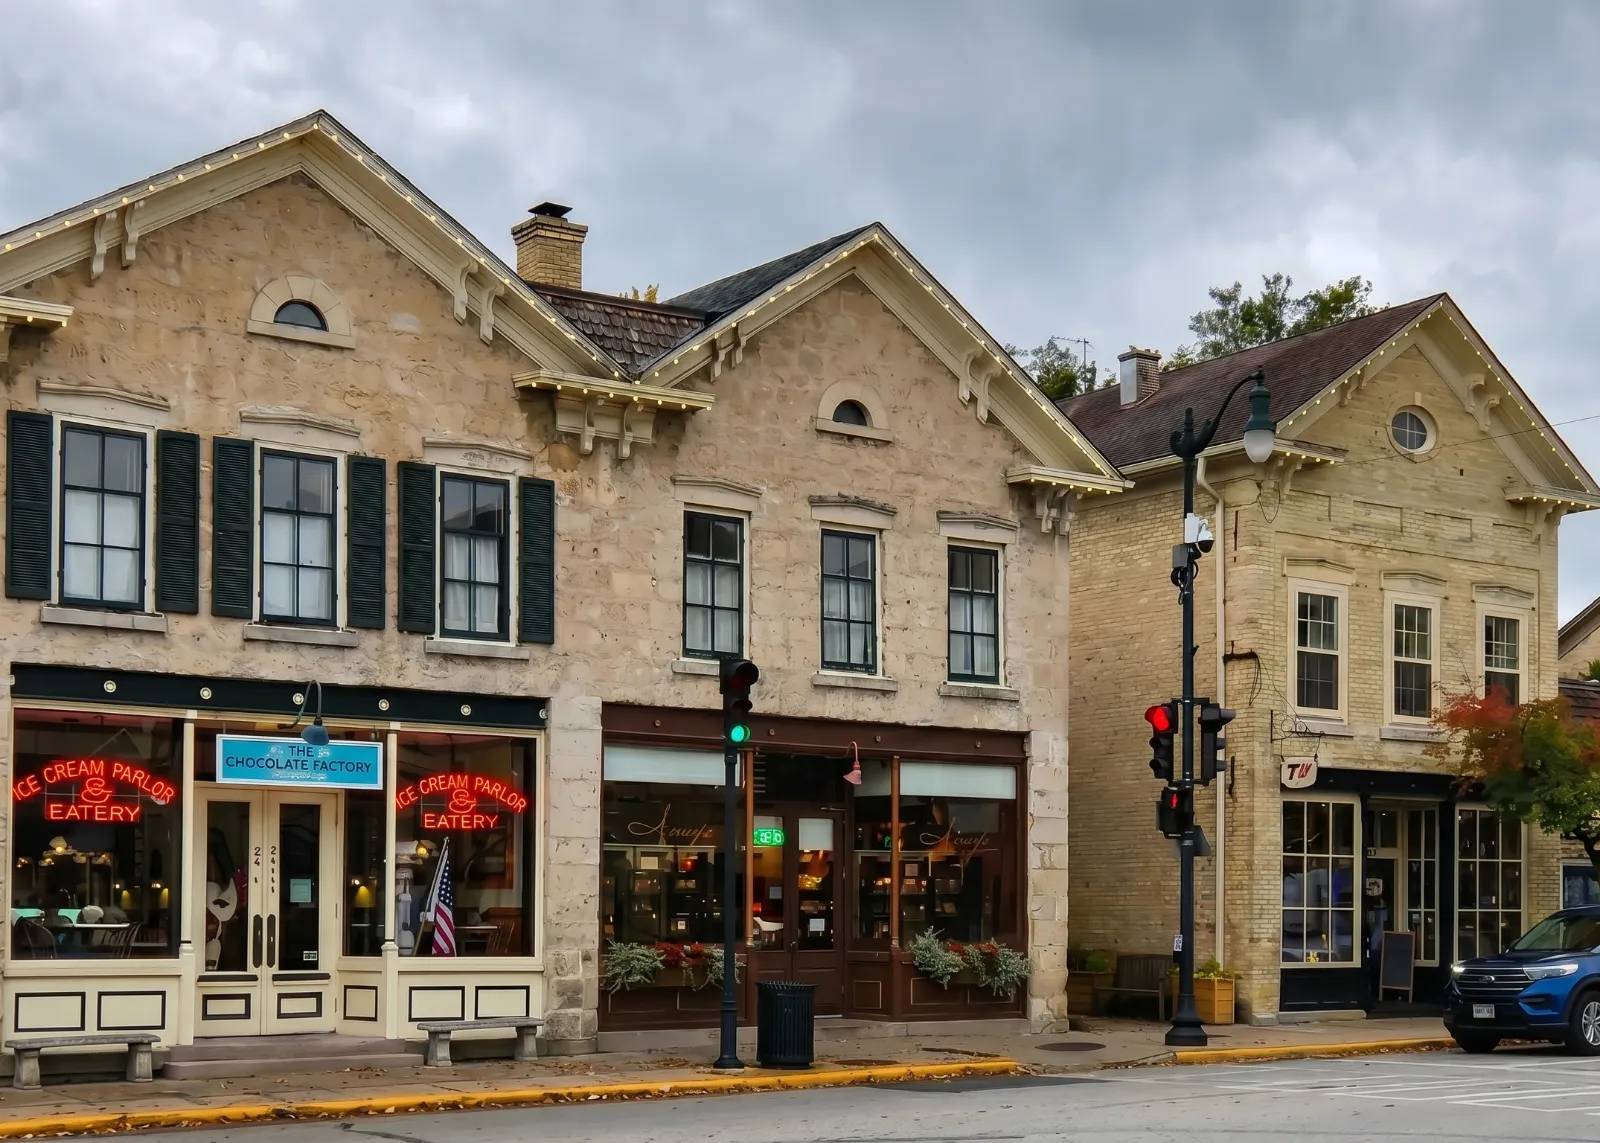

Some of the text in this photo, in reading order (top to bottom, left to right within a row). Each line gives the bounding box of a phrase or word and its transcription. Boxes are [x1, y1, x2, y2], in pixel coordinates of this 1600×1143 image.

[288, 745, 315, 758] THE
[225, 756, 372, 773] CHOCOLATE FACTORY
[1287, 762, 1313, 781] TW
[13, 760, 175, 804] ICE CREAM PARLOR
[395, 774, 527, 814] ICE CREAM PARLOR
[50, 803, 140, 822] EATERY
[424, 813, 499, 829] EATERY
